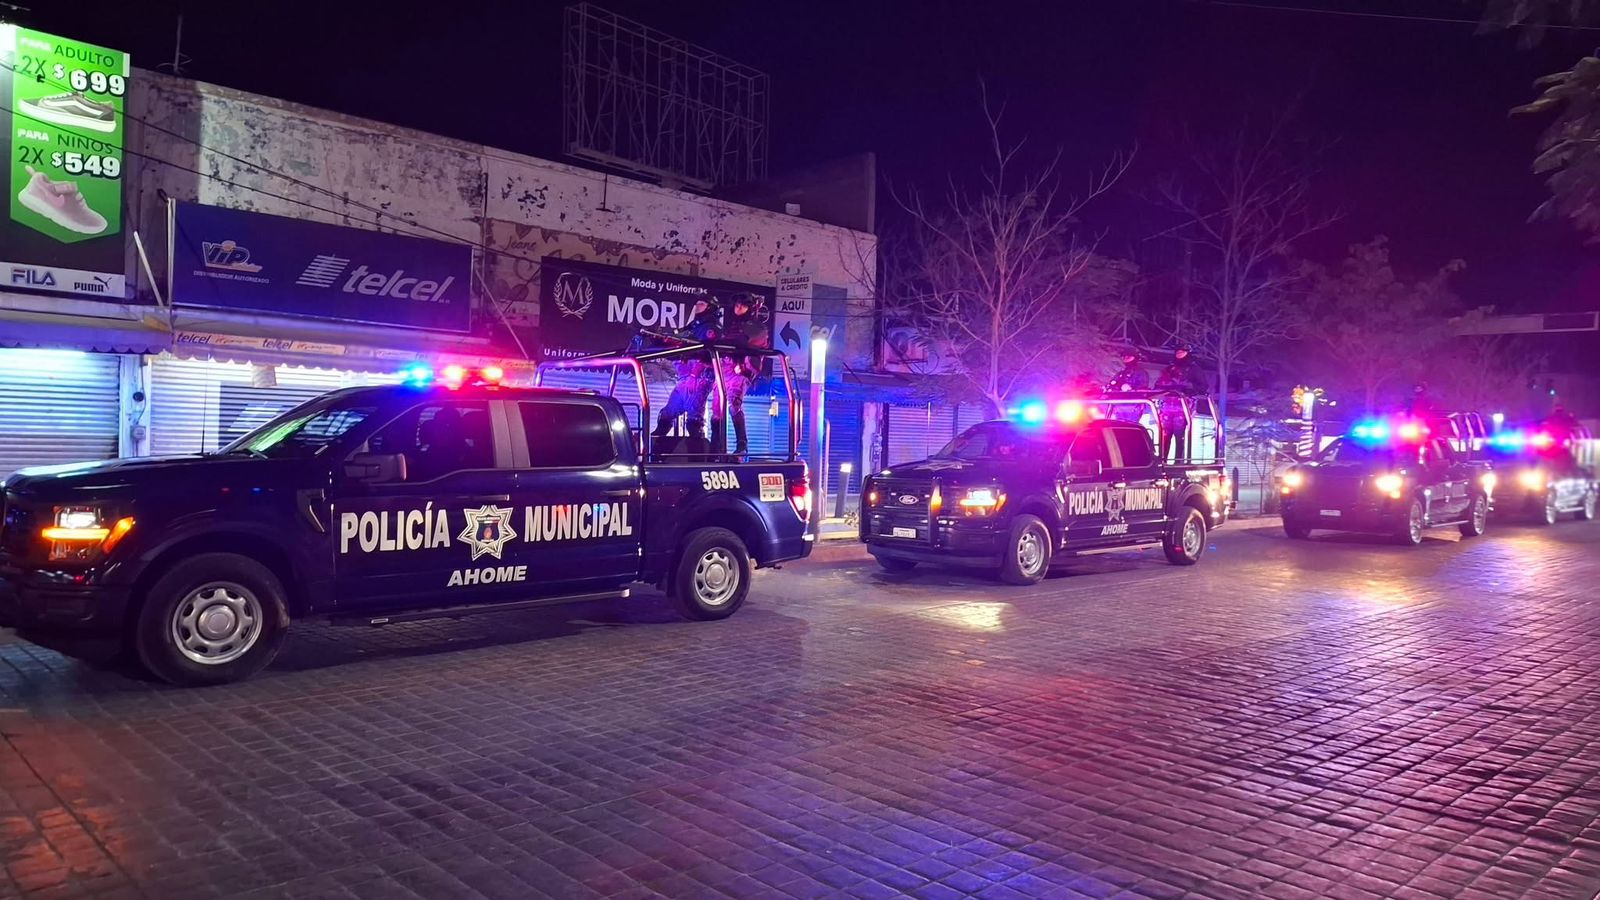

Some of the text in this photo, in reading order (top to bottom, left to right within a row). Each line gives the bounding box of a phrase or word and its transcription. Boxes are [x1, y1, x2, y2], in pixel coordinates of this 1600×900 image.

[54, 44, 115, 68] ADULTO
[21, 55, 47, 80] 2X
[69, 69, 126, 97] 699
[17, 128, 49, 142] PARA
[18, 145, 44, 166] 2X
[12, 268, 56, 286] FILA
[342, 265, 455, 302] telcel
[631, 277, 656, 290] Moda
[658, 280, 665, 293] y
[176, 332, 212, 344] telcel
[701, 470, 740, 490] 589A
[761, 476, 783, 486] 911
[1068, 487, 1104, 515] POLICÍA
[1124, 488, 1163, 511] MUNICIPAL
[340, 501, 451, 554] POLICÍA
[524, 502, 633, 543] MUNICIPAL
[1101, 524, 1129, 536] AHOME
[447, 565, 528, 588] AHOME
